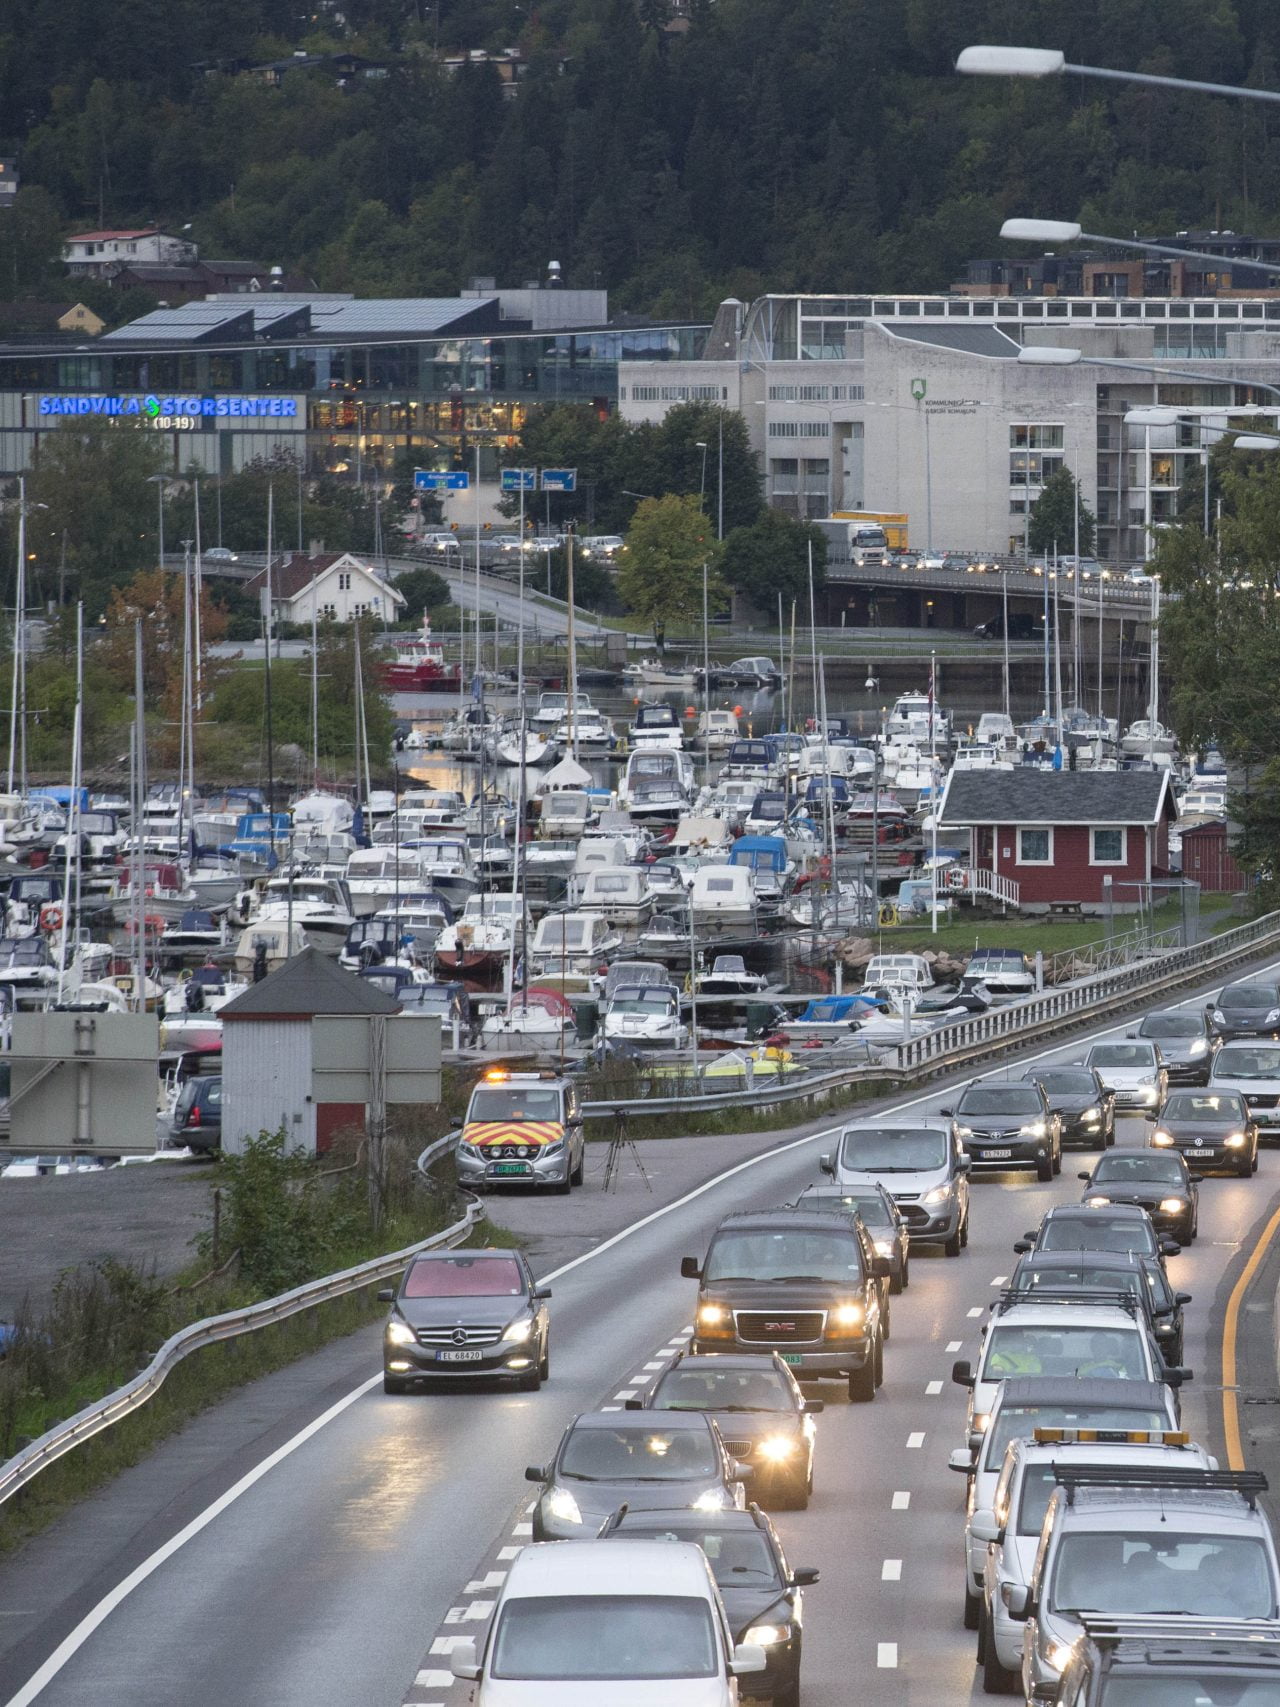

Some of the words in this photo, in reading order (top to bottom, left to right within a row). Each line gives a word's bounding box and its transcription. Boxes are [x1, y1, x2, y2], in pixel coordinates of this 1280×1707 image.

[39, 396, 140, 416] SANDVIKA
[159, 397, 297, 416] STORSENTER
[443, 1351, 452, 1360] EL
[454, 1351, 480, 1360] 68420
[783, 1355, 800, 1364] 083
